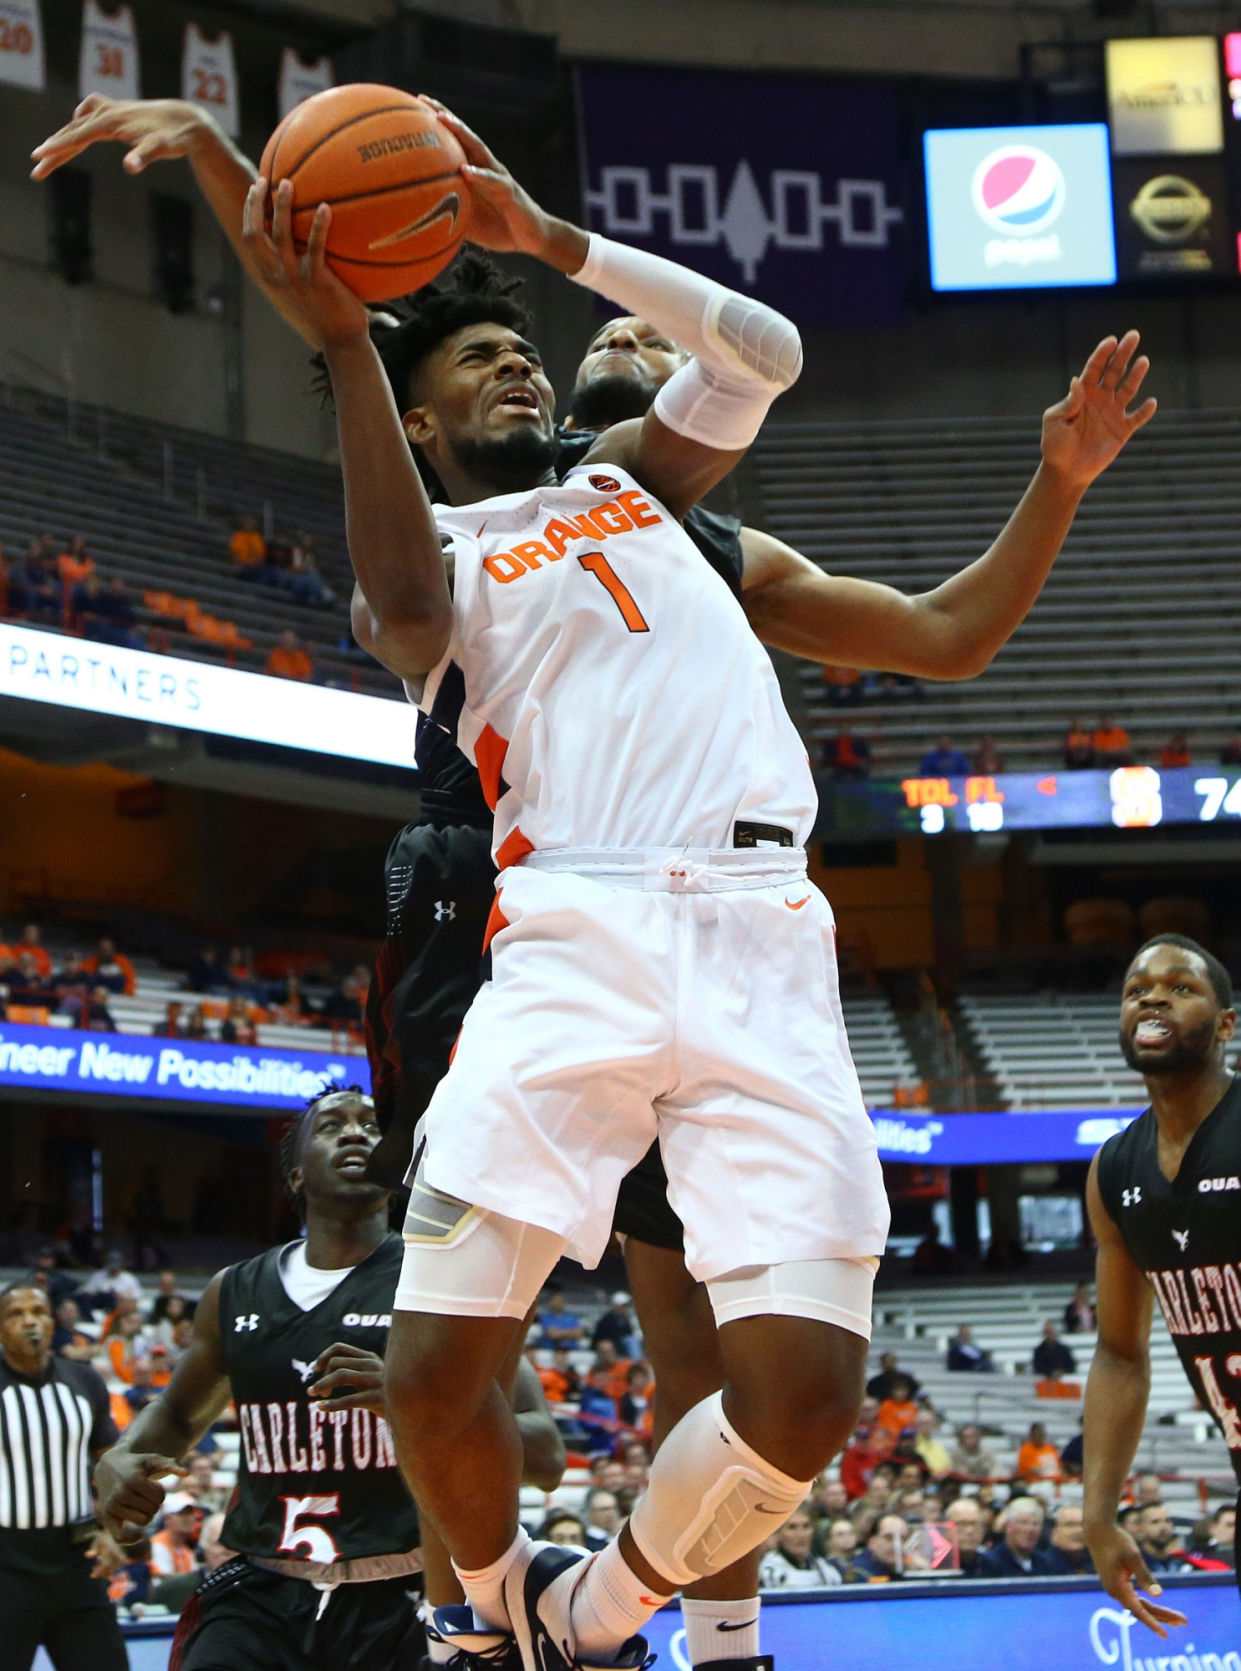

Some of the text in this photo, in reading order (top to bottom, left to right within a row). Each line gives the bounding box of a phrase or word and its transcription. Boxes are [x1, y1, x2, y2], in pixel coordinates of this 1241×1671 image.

[482, 490, 663, 584] ORANGE
[577, 552, 650, 632] 1
[10, 645, 201, 711] PARTNERS
[0, 1042, 76, 1076] neer
[78, 1041, 153, 1083] New
[1198, 1176, 1241, 1193] OUA
[342, 1312, 393, 1328] OUA
[1147, 1263, 1241, 1335] ARLETO
[240, 1401, 398, 1474] CARLETON
[277, 1491, 343, 1565] 5
